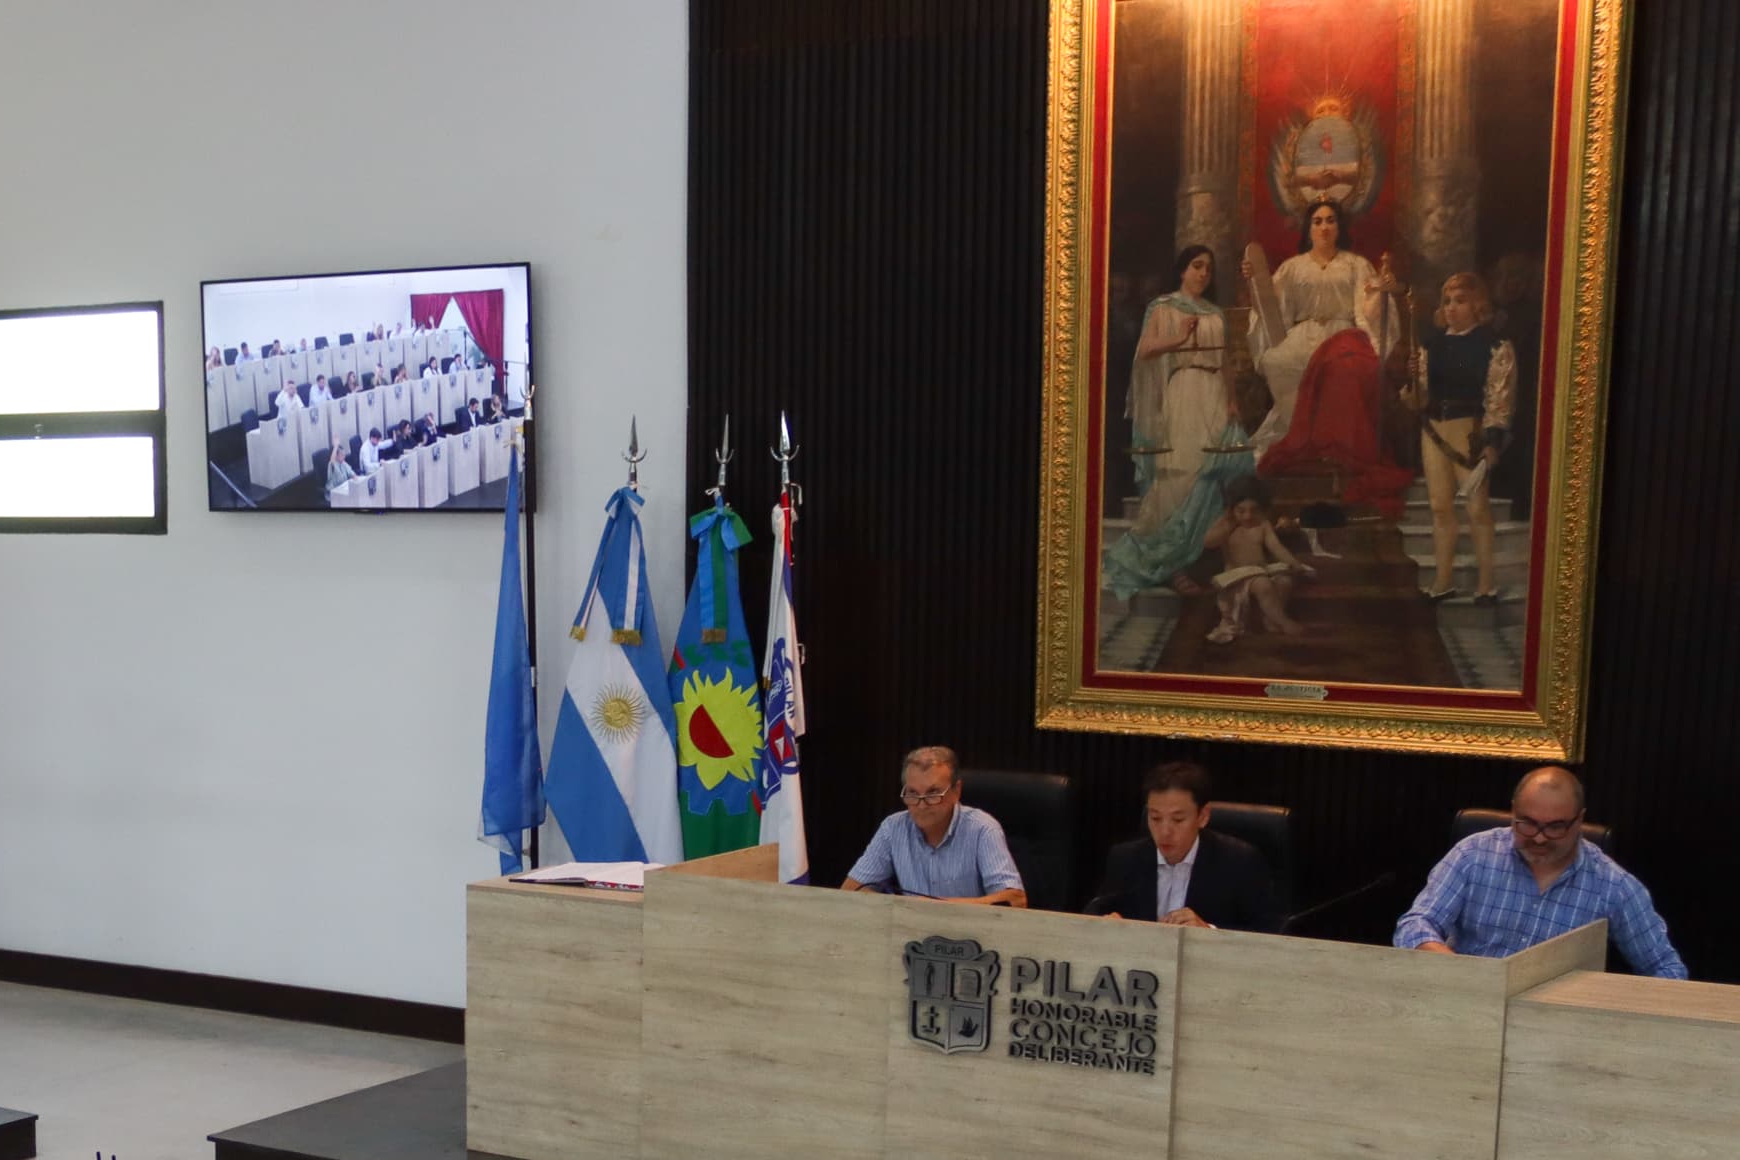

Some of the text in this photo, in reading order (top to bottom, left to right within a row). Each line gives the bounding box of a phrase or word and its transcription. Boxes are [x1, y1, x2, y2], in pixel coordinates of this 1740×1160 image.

[1010, 956, 1159, 1009] PILAR
[1011, 997, 1158, 1033] HONORABLE
[1010, 1017, 1157, 1058] CONCEJO
[1008, 1040, 1155, 1076] DELIBERANTE
